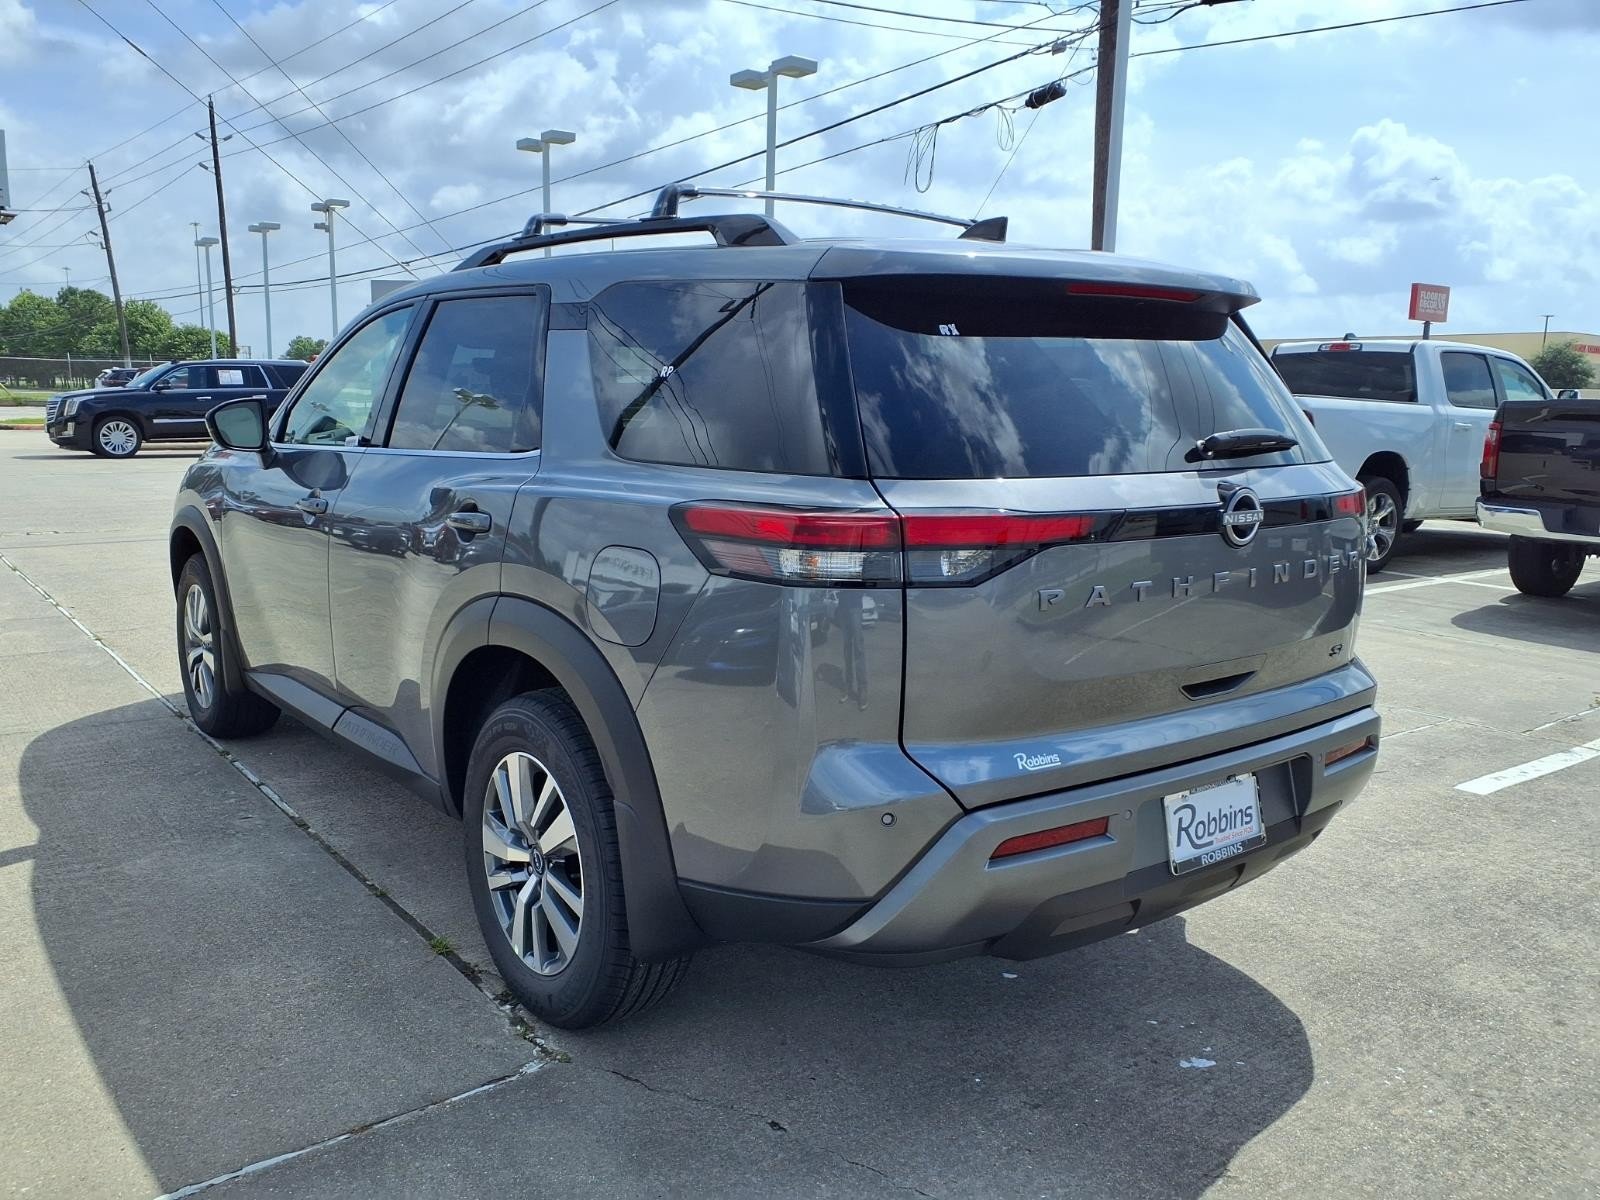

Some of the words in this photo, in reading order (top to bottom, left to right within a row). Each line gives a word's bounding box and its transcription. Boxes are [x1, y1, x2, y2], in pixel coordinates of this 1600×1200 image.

[1224, 512, 1264, 523] NISSAN
[1038, 551, 1358, 611] PATHFINDER
[1013, 753, 1061, 770] Robbins
[1173, 804, 1253, 850] Robbins
[1201, 842, 1244, 865] ROBBINS
